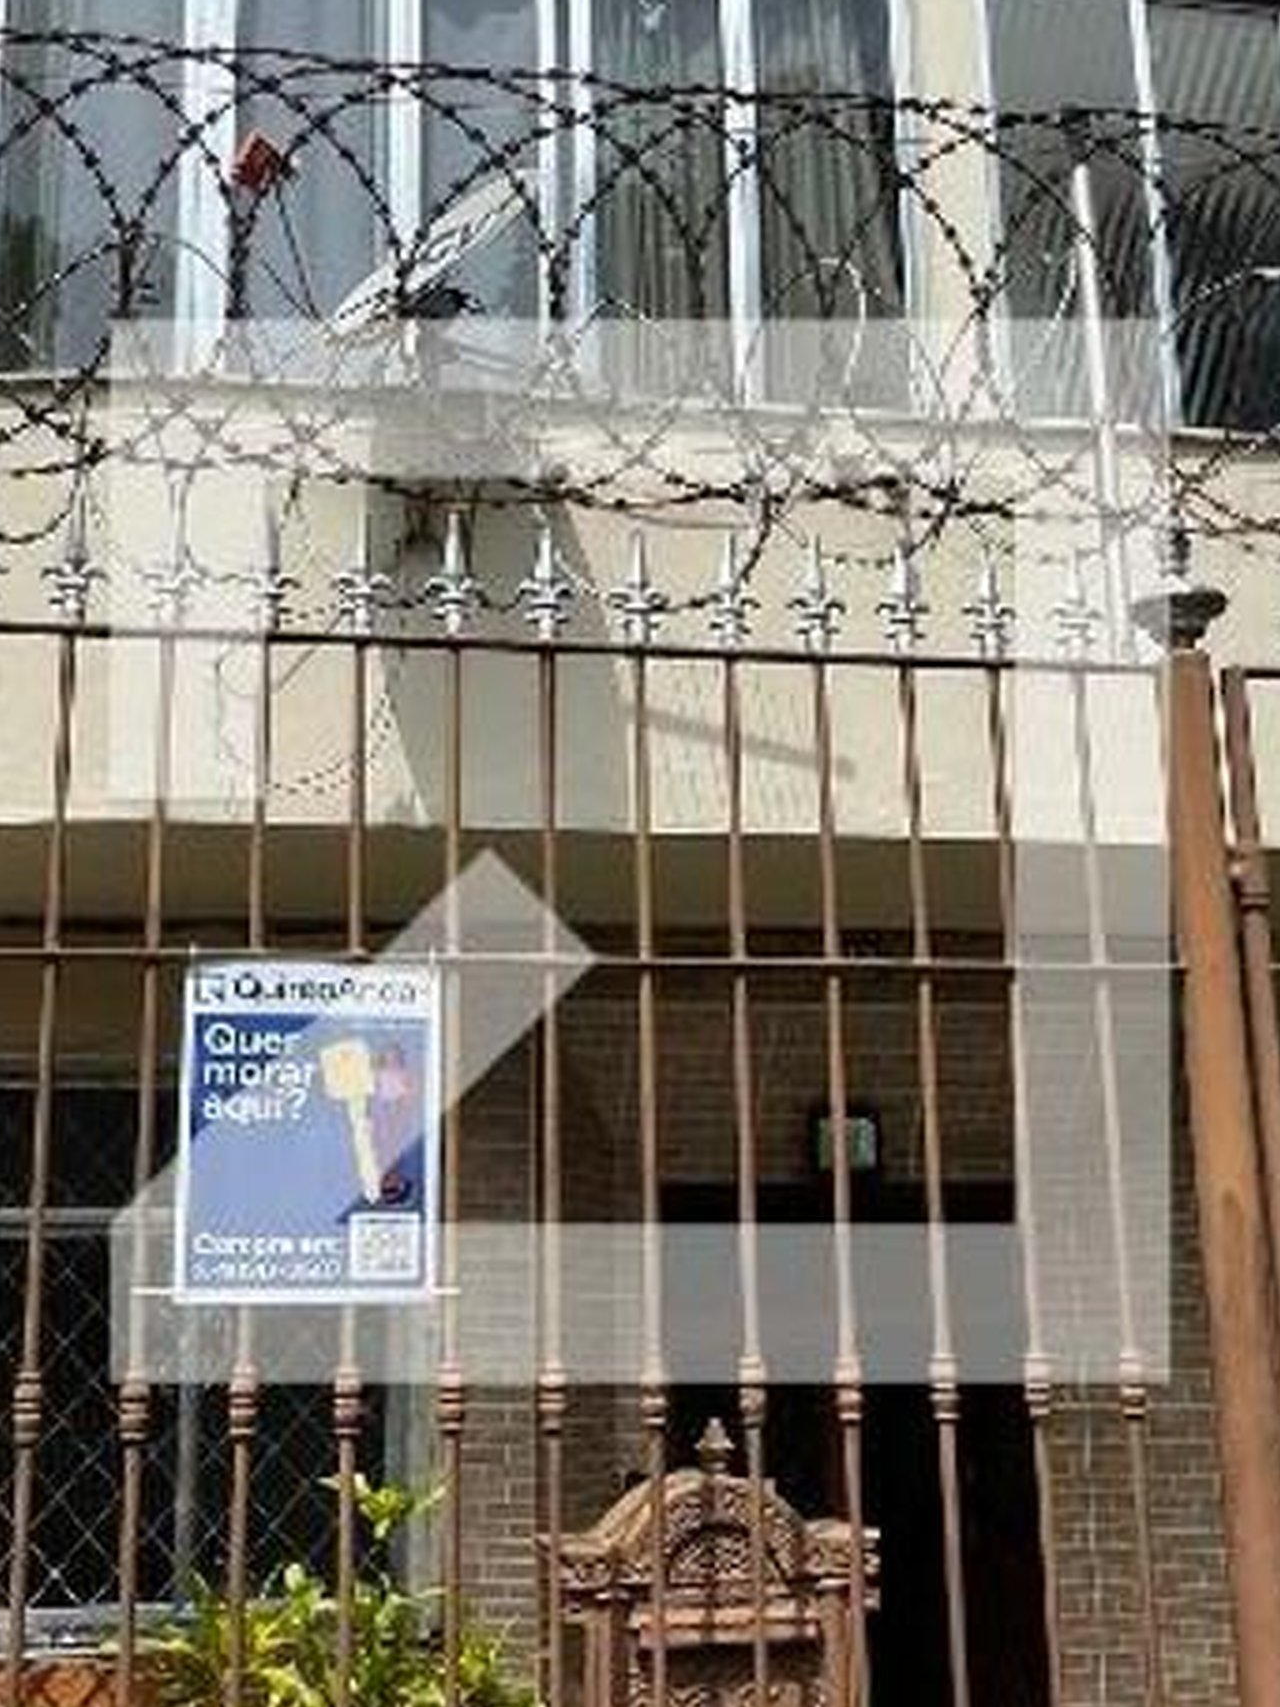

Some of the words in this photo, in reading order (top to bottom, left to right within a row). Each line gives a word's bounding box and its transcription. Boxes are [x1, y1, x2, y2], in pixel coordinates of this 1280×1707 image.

[203, 1022, 302, 1055] Quer
[203, 1060, 314, 1087] morar
[202, 1088, 308, 1124] aqui?
